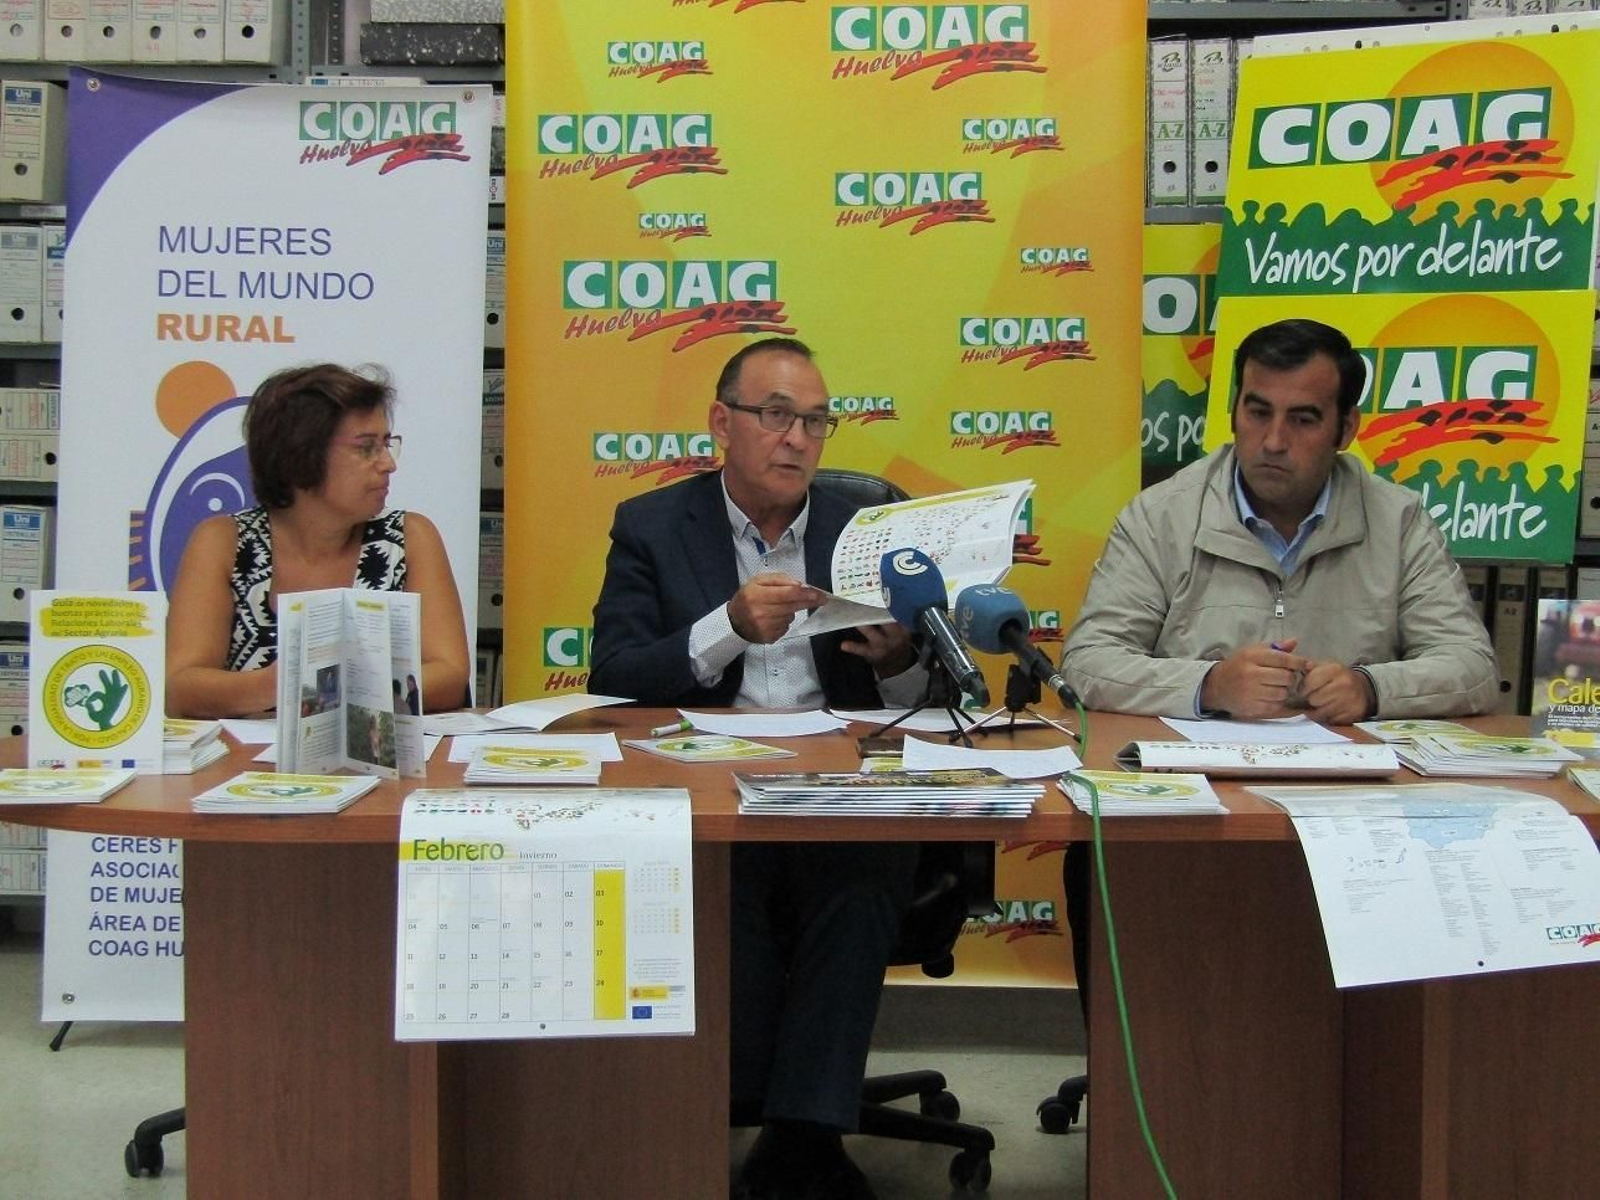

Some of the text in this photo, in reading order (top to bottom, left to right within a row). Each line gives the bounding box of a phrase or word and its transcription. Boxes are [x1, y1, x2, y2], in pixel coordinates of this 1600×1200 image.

[833, 6, 1023, 50] COAG
[609, 41, 702, 63] COAG
[832, 50, 922, 79] Huelva
[303, 102, 452, 140] COAG
[964, 119, 1054, 140] COAG
[1258, 93, 1545, 165] COAG
[540, 115, 708, 153] COAG
[300, 140, 372, 164] Huelva
[539, 152, 618, 179] Huelva
[837, 173, 979, 204] COAG
[640, 214, 705, 228] COAG
[835, 205, 903, 227] Huelva
[158, 226, 332, 256] MUJERES
[1021, 248, 1088, 263] COAG
[1245, 218, 1563, 293] Vamos por delante
[157, 270, 375, 300] DEL MUNDO
[567, 262, 772, 307] COAG
[157, 314, 295, 343] RURAL
[565, 307, 662, 339] Huelva
[962, 318, 1083, 345] COAG
[961, 344, 1018, 363] Huelva
[829, 397, 893, 412] COAG
[952, 412, 1051, 434] COAG
[595, 434, 713, 460] COAG
[545, 671, 590, 691] Hue
[1558, 704, 1585, 714] mapa
[92, 837, 162, 853] CERES
[412, 838, 505, 861] Febrero
[91, 887, 118, 902] DE
[89, 911, 146, 931] ÁREA
[502, 922, 511, 930] 07
[88, 940, 149, 957] COAG
[502, 982, 509, 990] 21
